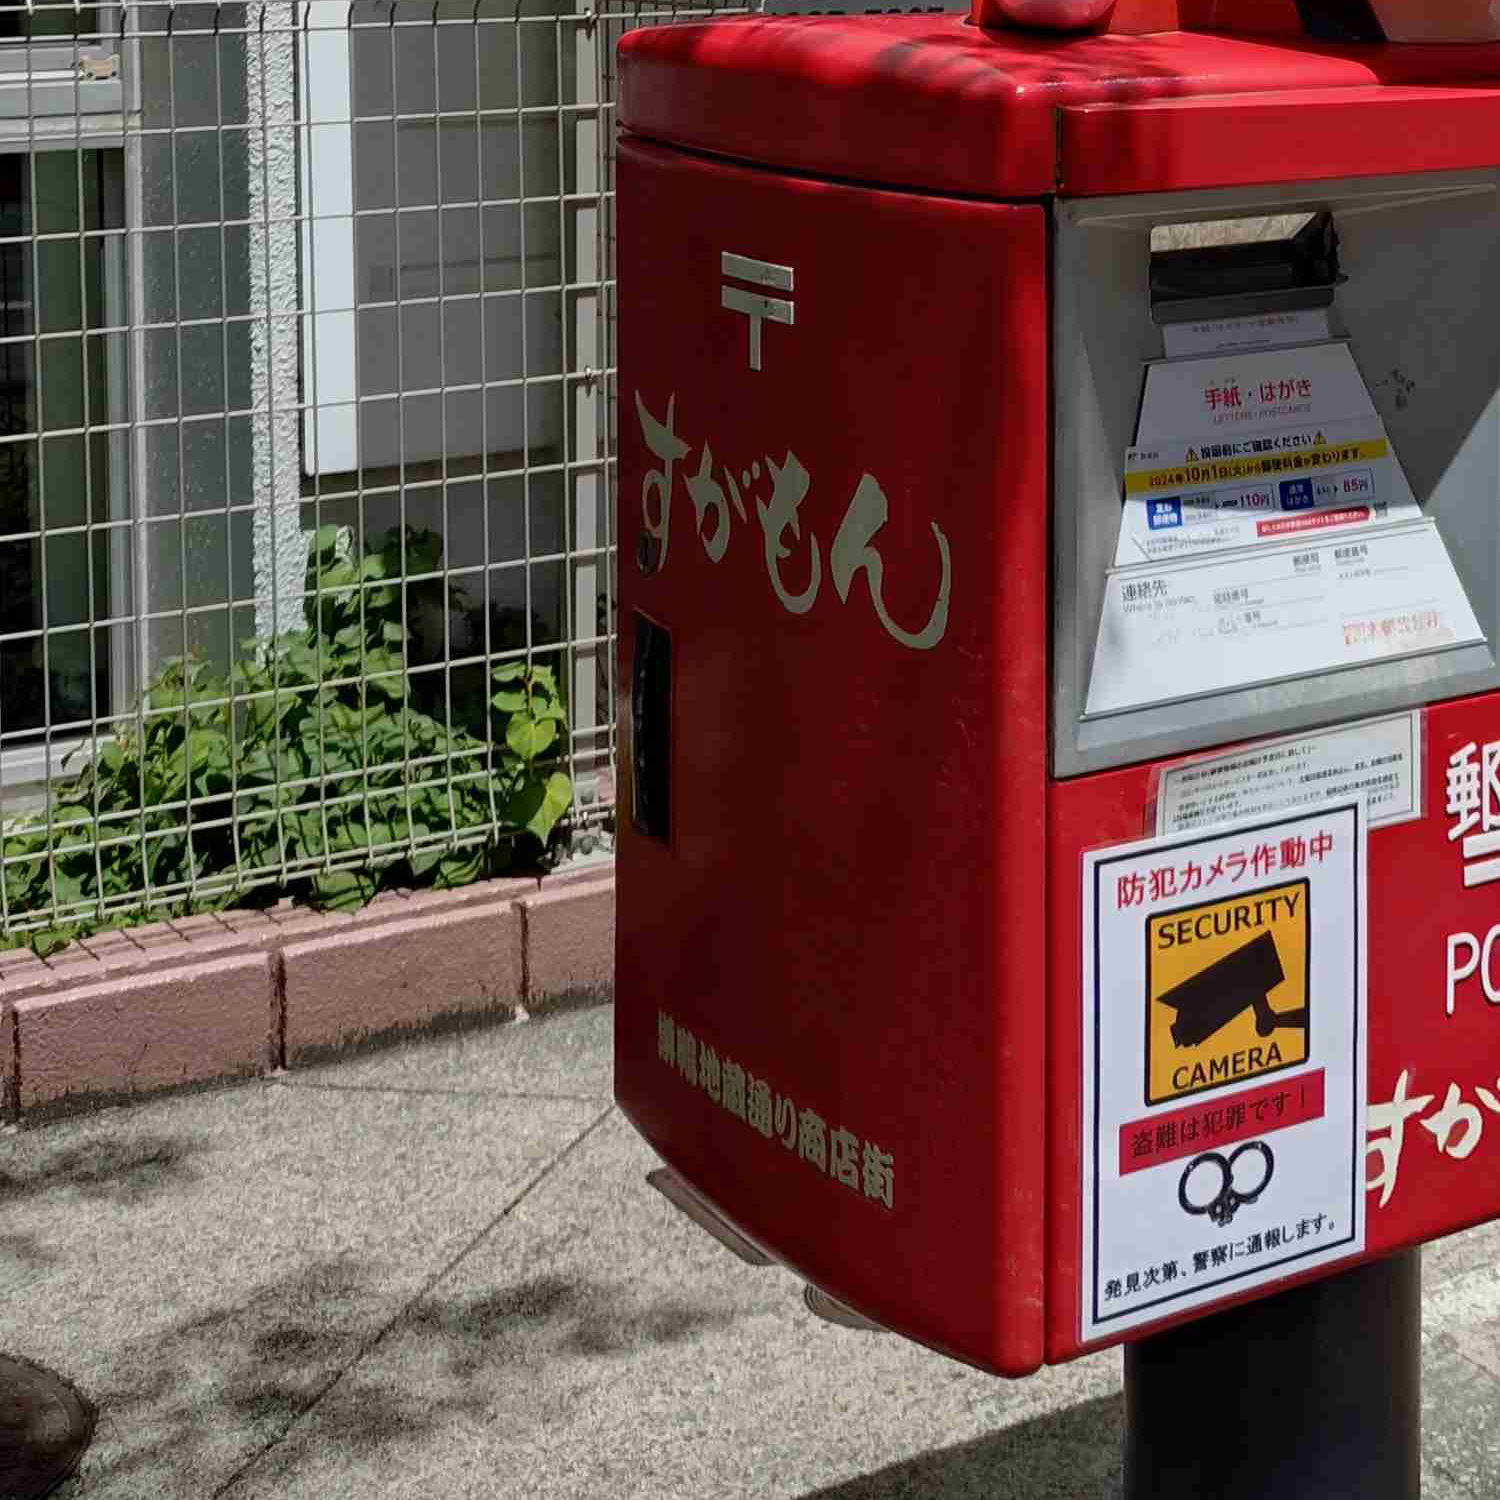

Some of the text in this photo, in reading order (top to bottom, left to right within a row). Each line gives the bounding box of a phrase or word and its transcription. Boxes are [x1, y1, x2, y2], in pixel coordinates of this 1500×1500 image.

[1204, 378, 1313, 411] 手紙・はがき
[633, 387, 952, 651] すがもん
[1121, 579, 1169, 602] 連絡先
[1116, 828, 1335, 910] 防犯カメラ作動中
[1156, 890, 1302, 951] SECURITY
[1171, 1045, 1284, 1093] CAMERA
[1103, 1214, 1338, 1302] 発見次第、警察に通報します。
